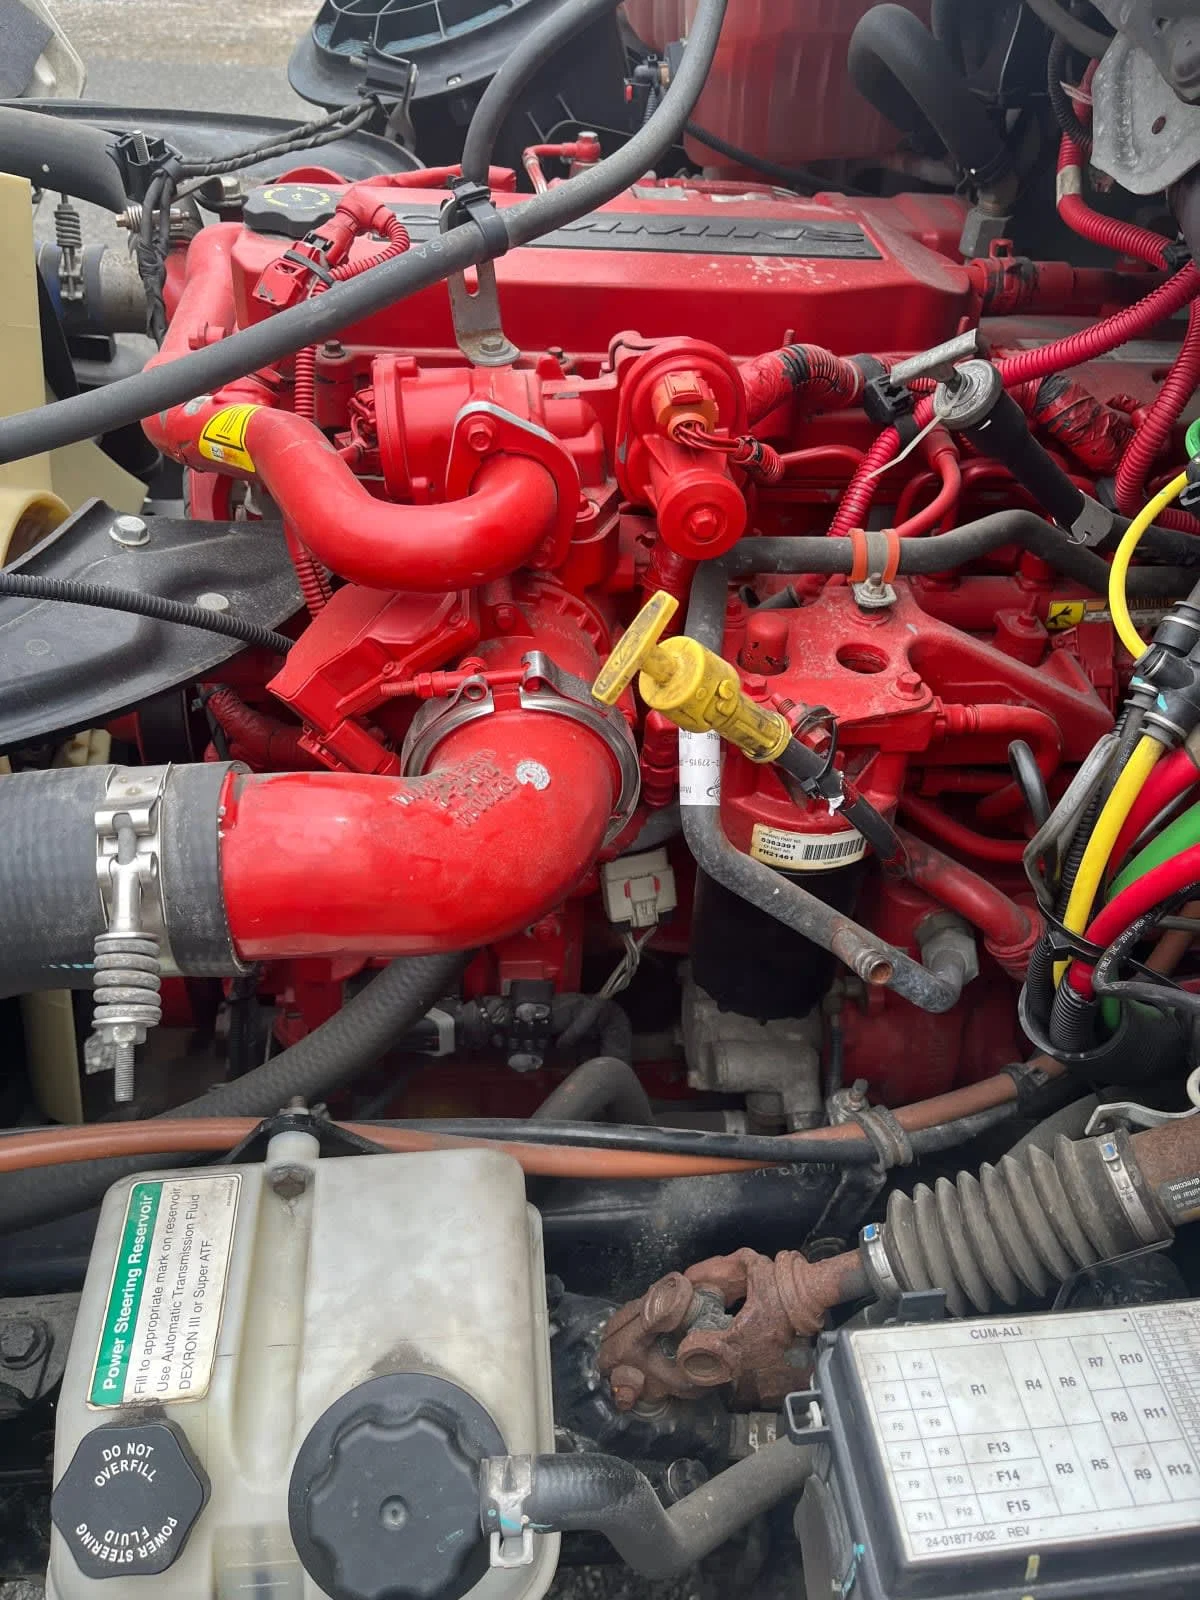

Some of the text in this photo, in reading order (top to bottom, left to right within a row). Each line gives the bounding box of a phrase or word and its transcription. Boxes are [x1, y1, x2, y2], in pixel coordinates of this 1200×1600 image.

[400, 213, 866, 244] CMMINS
[163, 1238, 172, 1252] on
[156, 1256, 170, 1282] mark
[194, 1259, 210, 1298] Super
[103, 1194, 154, 1390] Power Steering Reservoir
[157, 1194, 200, 1392] Use Automatic Transmission Fluid
[193, 1301, 203, 1313] or
[144, 1285, 163, 1355] appropriate
[188, 1317, 201, 1329] III
[970, 1326, 1023, 1340] CUM-ALI
[139, 1358, 150, 1372] to
[179, 1330, 198, 1390] DEXRON
[912, 1360, 923, 1370] F2
[1088, 1356, 1104, 1368] R7
[1119, 1353, 1143, 1365] R10
[134, 1373, 148, 1394] Fill
[1025, 1378, 1042, 1391] R4
[1059, 1376, 1076, 1388] R6
[921, 1390, 932, 1399] F4
[970, 1383, 987, 1396] R1
[1111, 1411, 1128, 1423] R8
[1143, 1406, 1168, 1419] R11
[892, 1422, 904, 1432] F5
[929, 1418, 941, 1428] F6
[102, 1442, 154, 1461] DO NOT
[987, 1441, 1011, 1454] F13
[900, 1451, 911, 1461] F7
[1056, 1463, 1074, 1475] R3
[1091, 1459, 1109, 1471] R5
[1167, 1463, 1193, 1476] R12
[94, 1459, 157, 1487] OVERFILL
[996, 1469, 1020, 1482] F14
[1134, 1468, 1152, 1481] R9
[908, 1479, 920, 1489] F9
[1007, 1498, 1031, 1512] F15
[917, 1511, 933, 1521] F11
[956, 1507, 973, 1517] F12
[76, 1516, 178, 1563] POWER STEERING
[104, 1526, 150, 1546] FLUID
[926, 1526, 1030, 1548] 24-01877-002 REV
